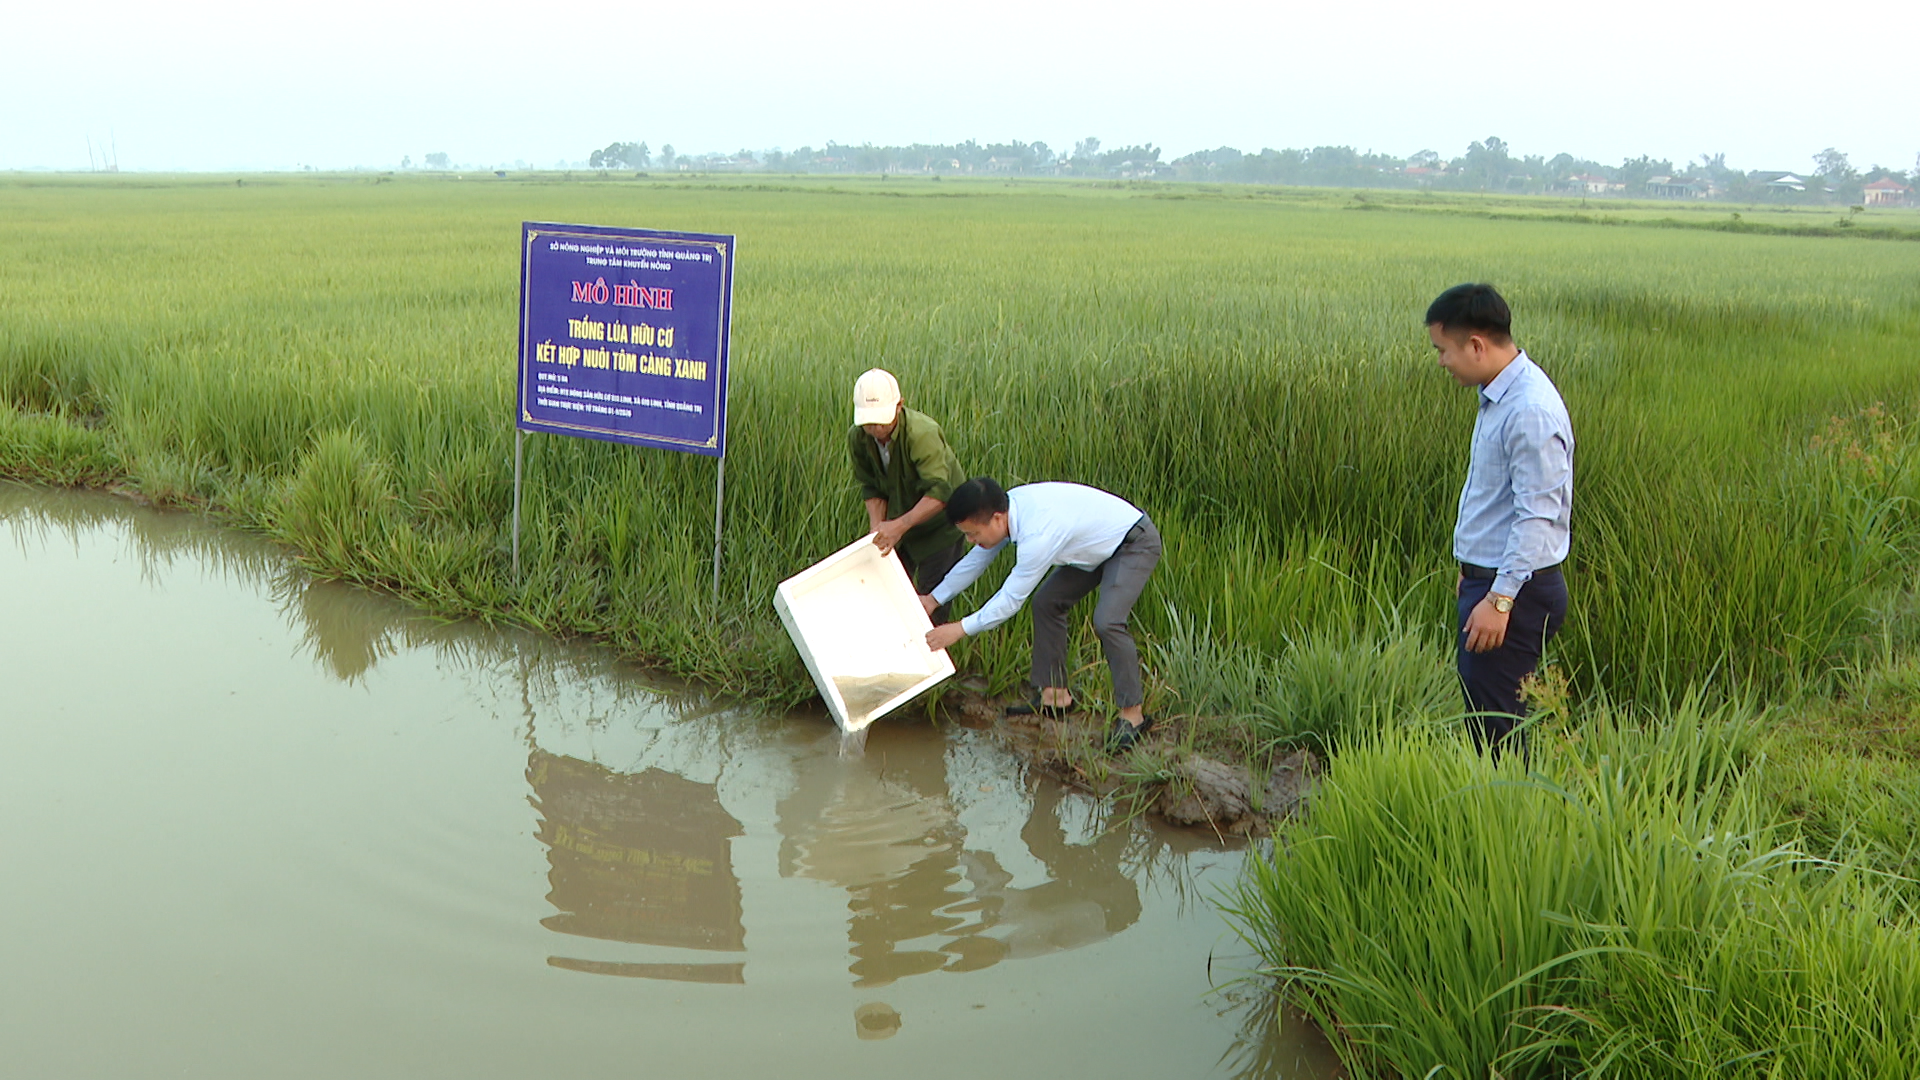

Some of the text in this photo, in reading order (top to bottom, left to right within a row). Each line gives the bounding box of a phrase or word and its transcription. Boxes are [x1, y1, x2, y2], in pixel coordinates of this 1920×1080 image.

[560, 242, 579, 252] NÔNG
[580, 244, 604, 255] NGHIỆP
[605, 246, 614, 255] VÀ
[616, 246, 629, 256] MÔI
[630, 247, 657, 258] TRƯỜNG
[659, 248, 674, 259] TỈNH
[675, 250, 700, 261] QUẢNG
[702, 253, 712, 264] TRỊ
[586, 257, 671, 270] TRUNG TÂM KHUYẾN NÔNG
[572, 277, 673, 310] MÔ HÌNH
[607, 320, 628, 344] LÚA
[631, 322, 655, 346] HỮU
[657, 326, 674, 348] CƠ
[536, 339, 707, 381] KẾT HỢP NUÔI TÔM CÀNG XANH
